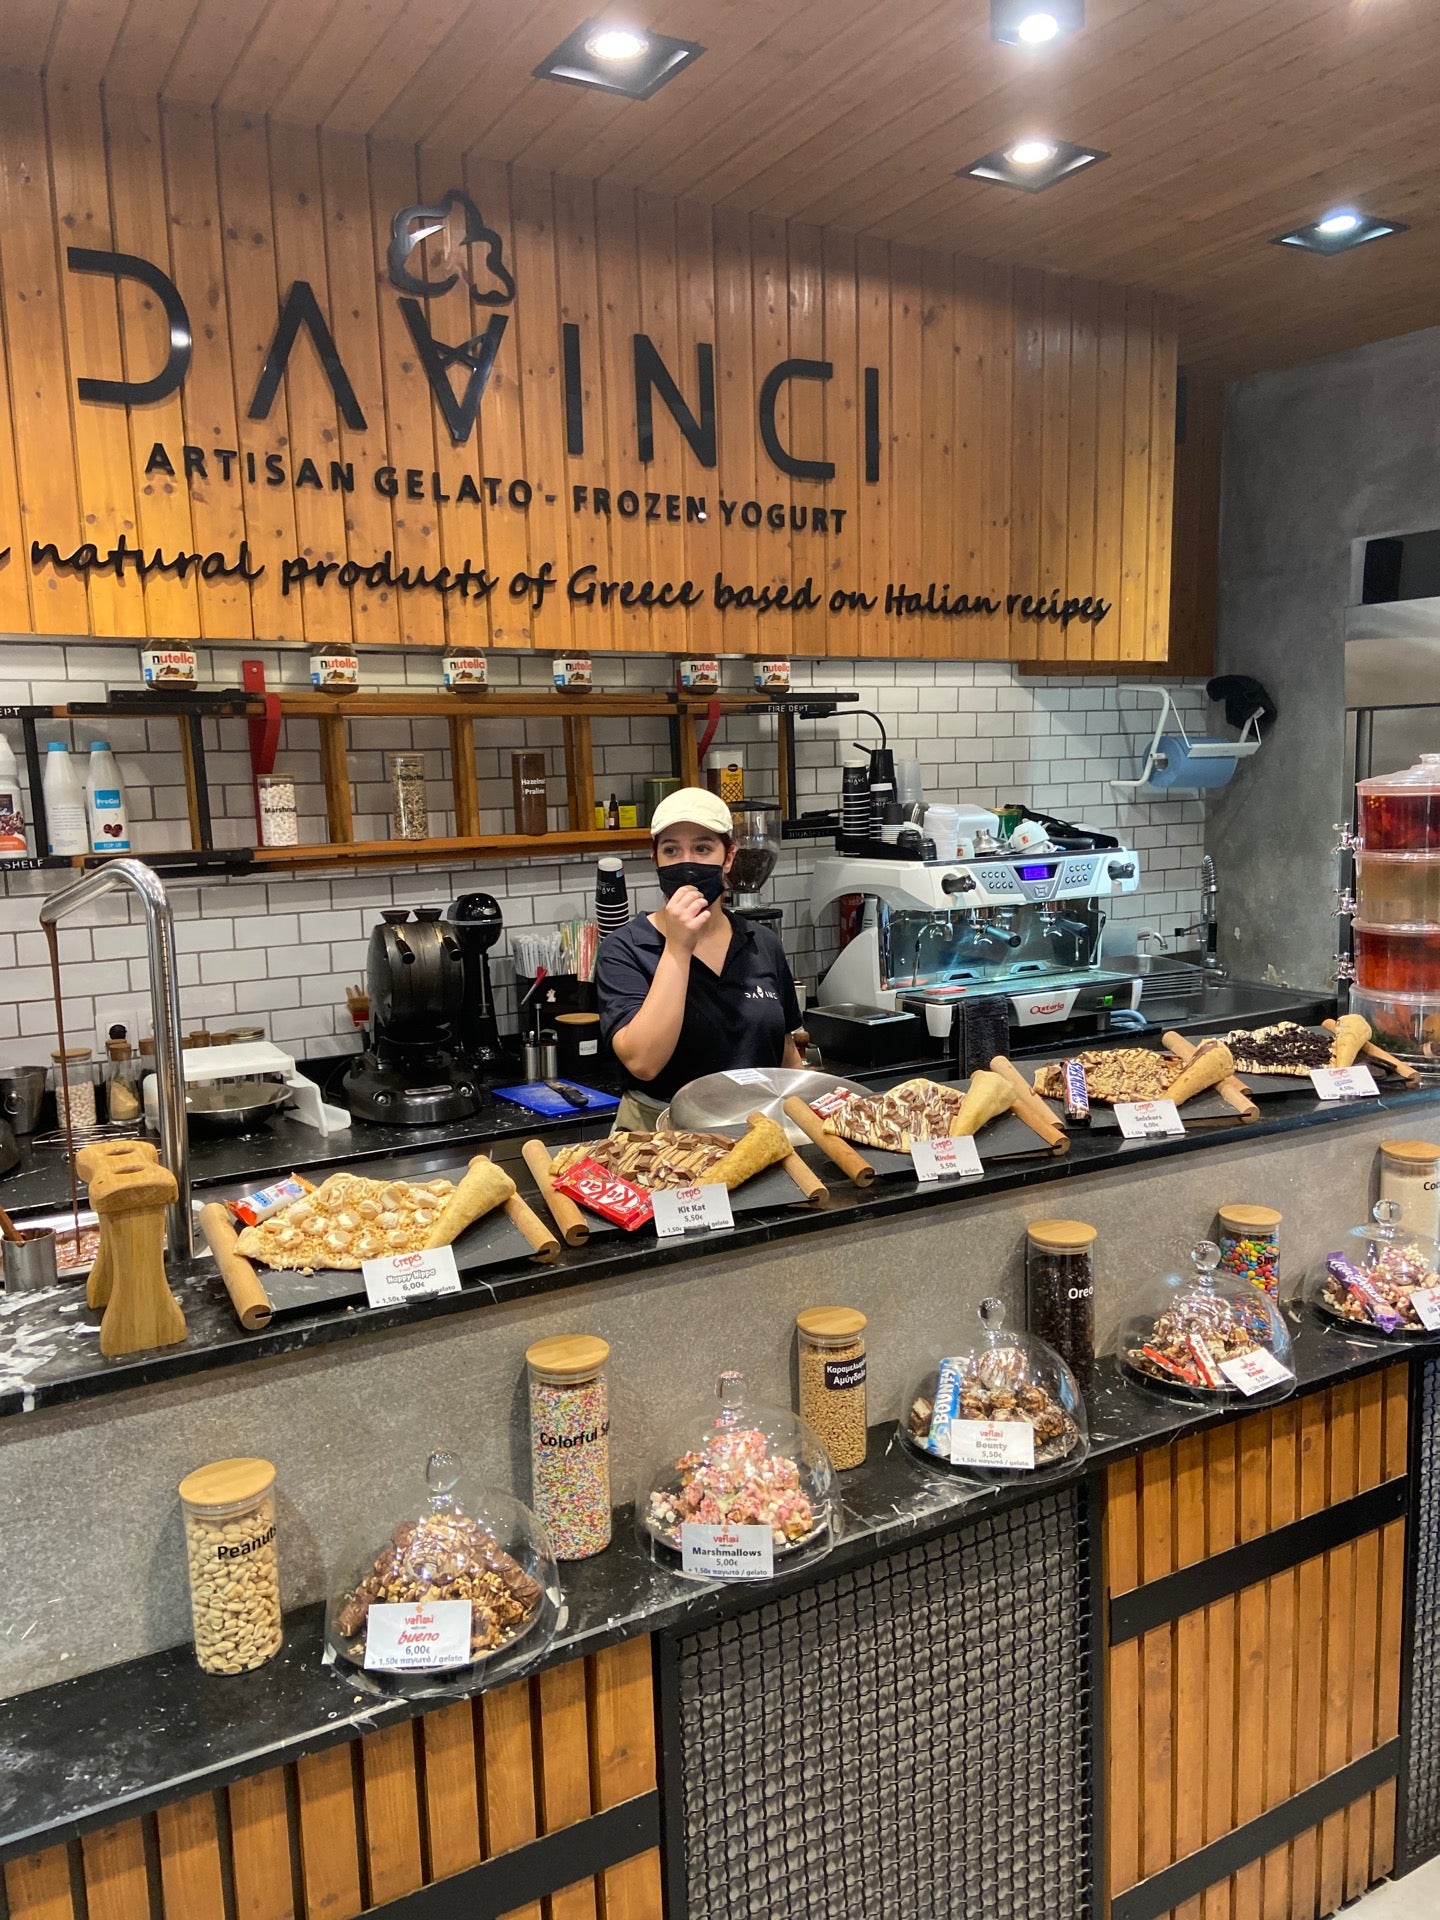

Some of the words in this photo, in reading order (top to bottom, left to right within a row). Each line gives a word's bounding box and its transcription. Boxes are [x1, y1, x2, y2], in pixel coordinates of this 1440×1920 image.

[145, 443, 355, 494] ARTISAN
[374, 466, 532, 507] GELATO
[573, 485, 706, 524] FROZEN
[719, 500, 847, 534] YOGURT
[31, 534, 266, 580] natural
[281, 550, 500, 598] products
[509, 562, 557, 610] of
[567, 564, 704, 608] Greece
[714, 572, 822, 613] based
[828, 588, 878, 613] on
[1006, 588, 1112, 627] recipes
[152, 653, 195, 665] nutella
[320, 658, 358, 670] nutella
[450, 659, 486, 670] nutella
[767, 705, 786, 713] FIRE
[788, 704, 809, 713] DEPT
[1069, 1061, 1088, 1107] SNICKERS
[676, 1187, 701, 1200] Crepes
[677, 1205, 691, 1214] Kit
[691, 1204, 706, 1212] Kat
[392, 1253, 422, 1268] Crepes
[402, 1281, 425, 1292] 6,00€
[1068, 1286, 1094, 1300] Oreo
[933, 1366, 957, 1425] BOUNTY
[540, 1428, 598, 1449] Colorful
[975, 1441, 1008, 1451] Bounty
[692, 1546, 762, 1557] Marshmallows
[746, 1569, 768, 1577] gelato
[397, 1630, 441, 1646] bueno
[405, 1644, 431, 1657] 6,00€
[439, 1654, 463, 1664] gelato
